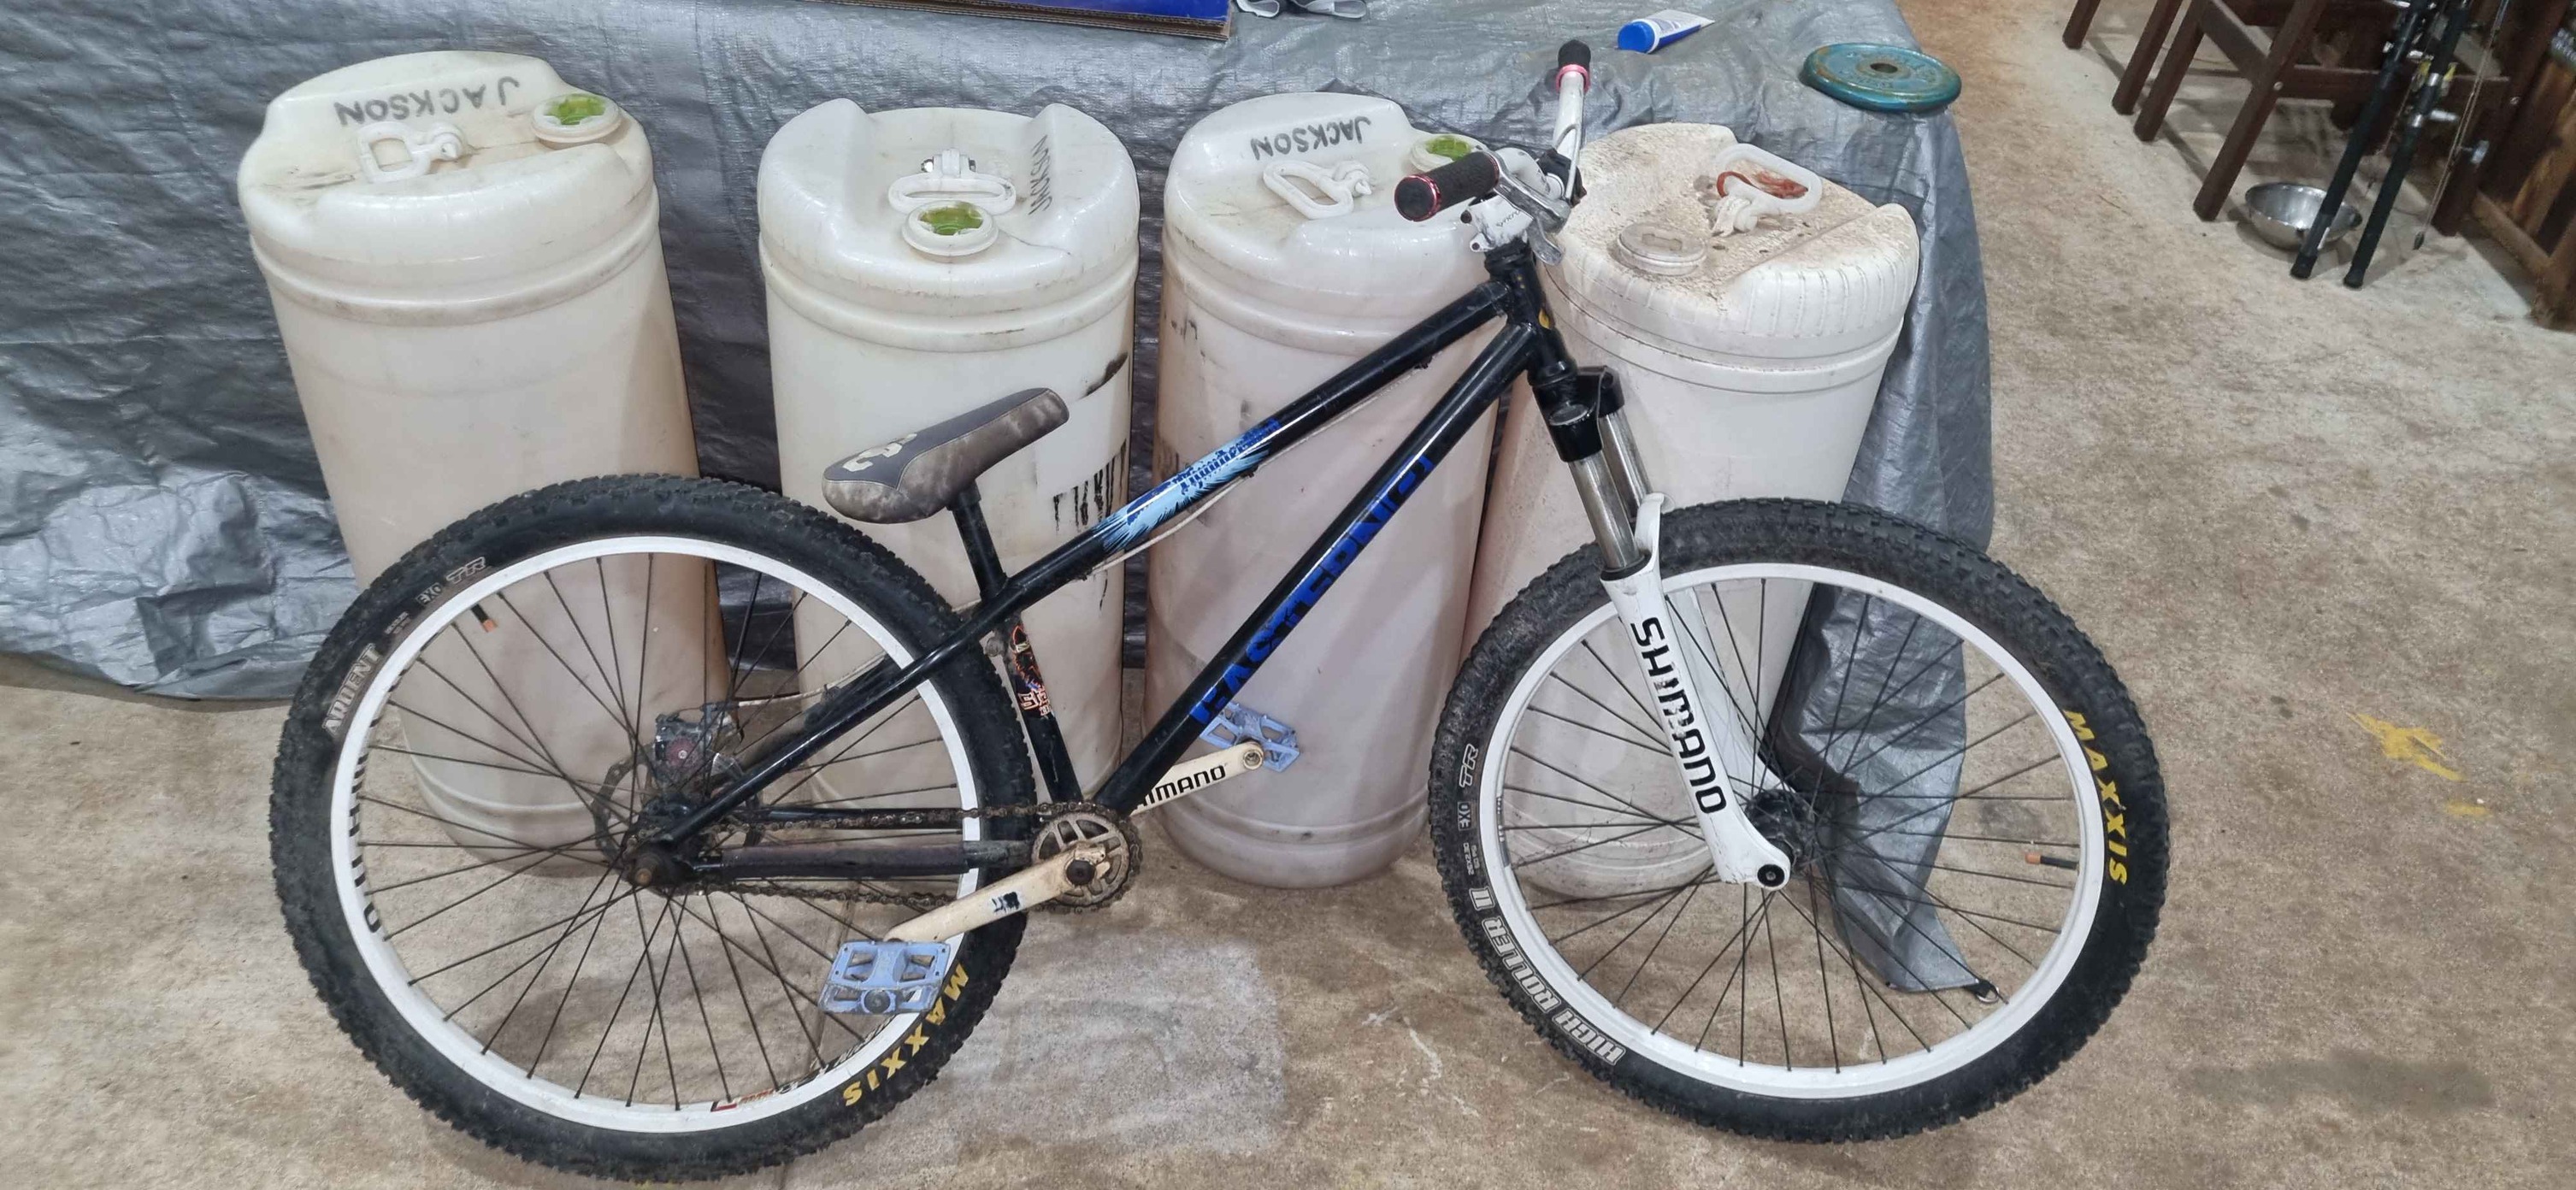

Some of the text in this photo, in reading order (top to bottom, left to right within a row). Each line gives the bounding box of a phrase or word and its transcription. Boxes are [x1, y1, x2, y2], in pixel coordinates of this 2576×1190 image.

[334, 76, 519, 127] JACKSON
[1251, 116, 1371, 161] JACKSON
[416, 582, 444, 606] EXO
[322, 643, 383, 736] ARDENT
[1630, 617, 1727, 814] SHIMANO
[1134, 765, 1226, 809] IMANO
[2063, 710, 2128, 885] MAXXIS
[1458, 801, 1471, 832] EXO
[1482, 917, 1560, 1012] ROLLER
[843, 963, 969, 1106] MAXXIS
[1553, 1008, 1625, 1065] HIGH
